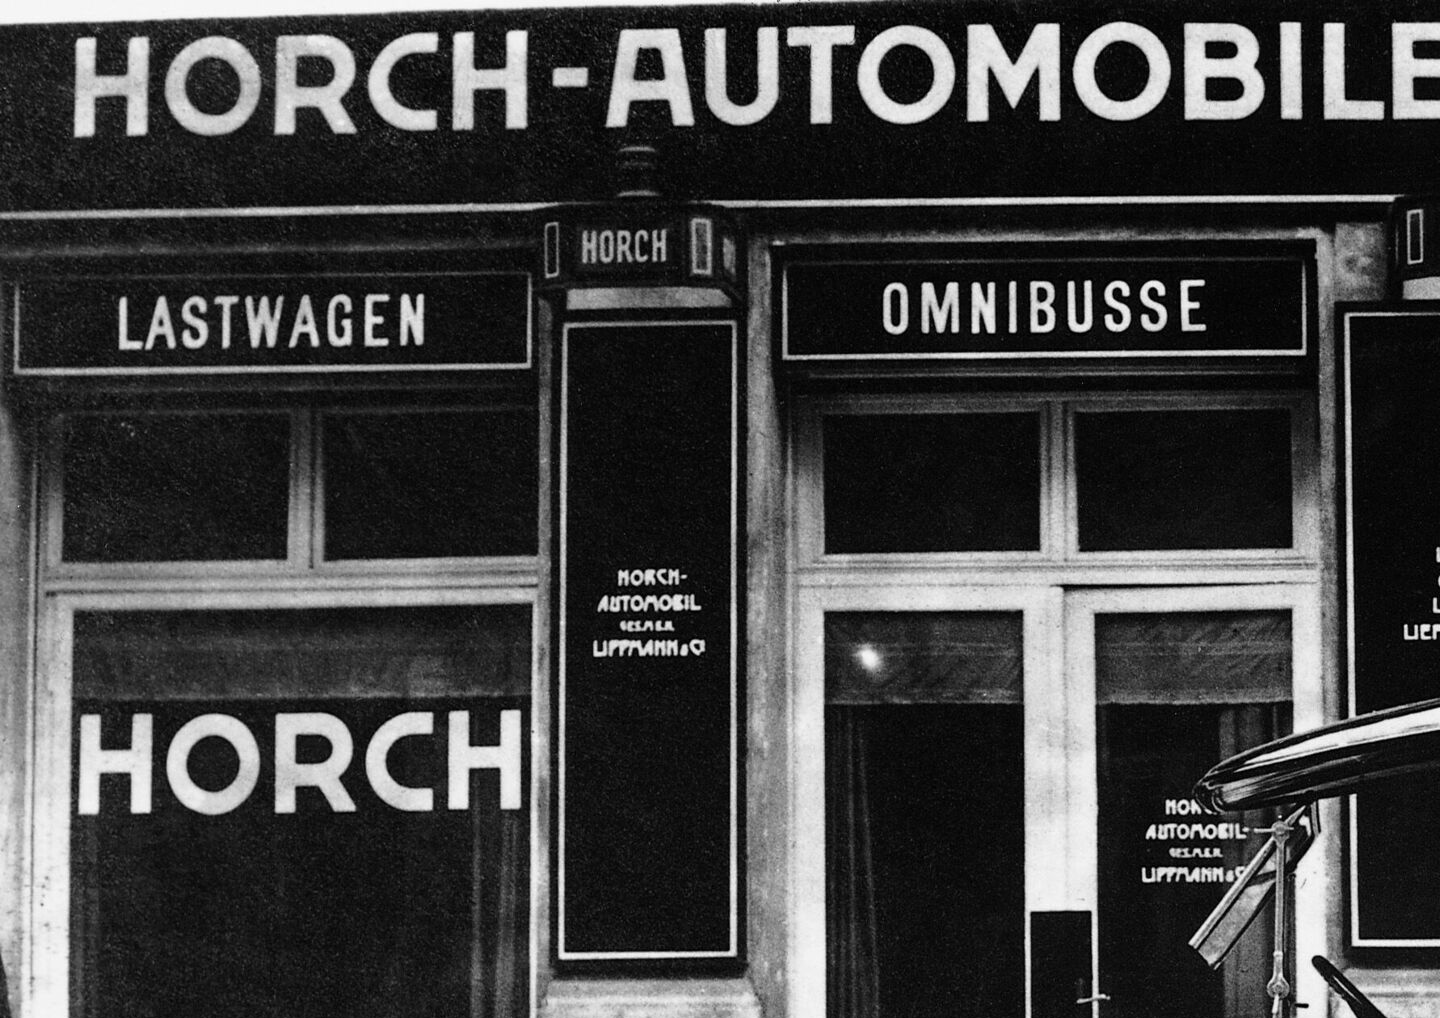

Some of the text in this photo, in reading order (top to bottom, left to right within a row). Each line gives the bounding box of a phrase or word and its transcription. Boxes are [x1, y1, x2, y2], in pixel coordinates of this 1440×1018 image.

[582, 229, 667, 264] HORCH
[118, 293, 425, 351] LASTWAGEN
[882, 279, 1207, 335] OMNIBUSSE
[597, 594, 702, 613] AUTOMOBIL
[78, 709, 522, 815] HORCH
[1165, 799, 1213, 815] HOR
